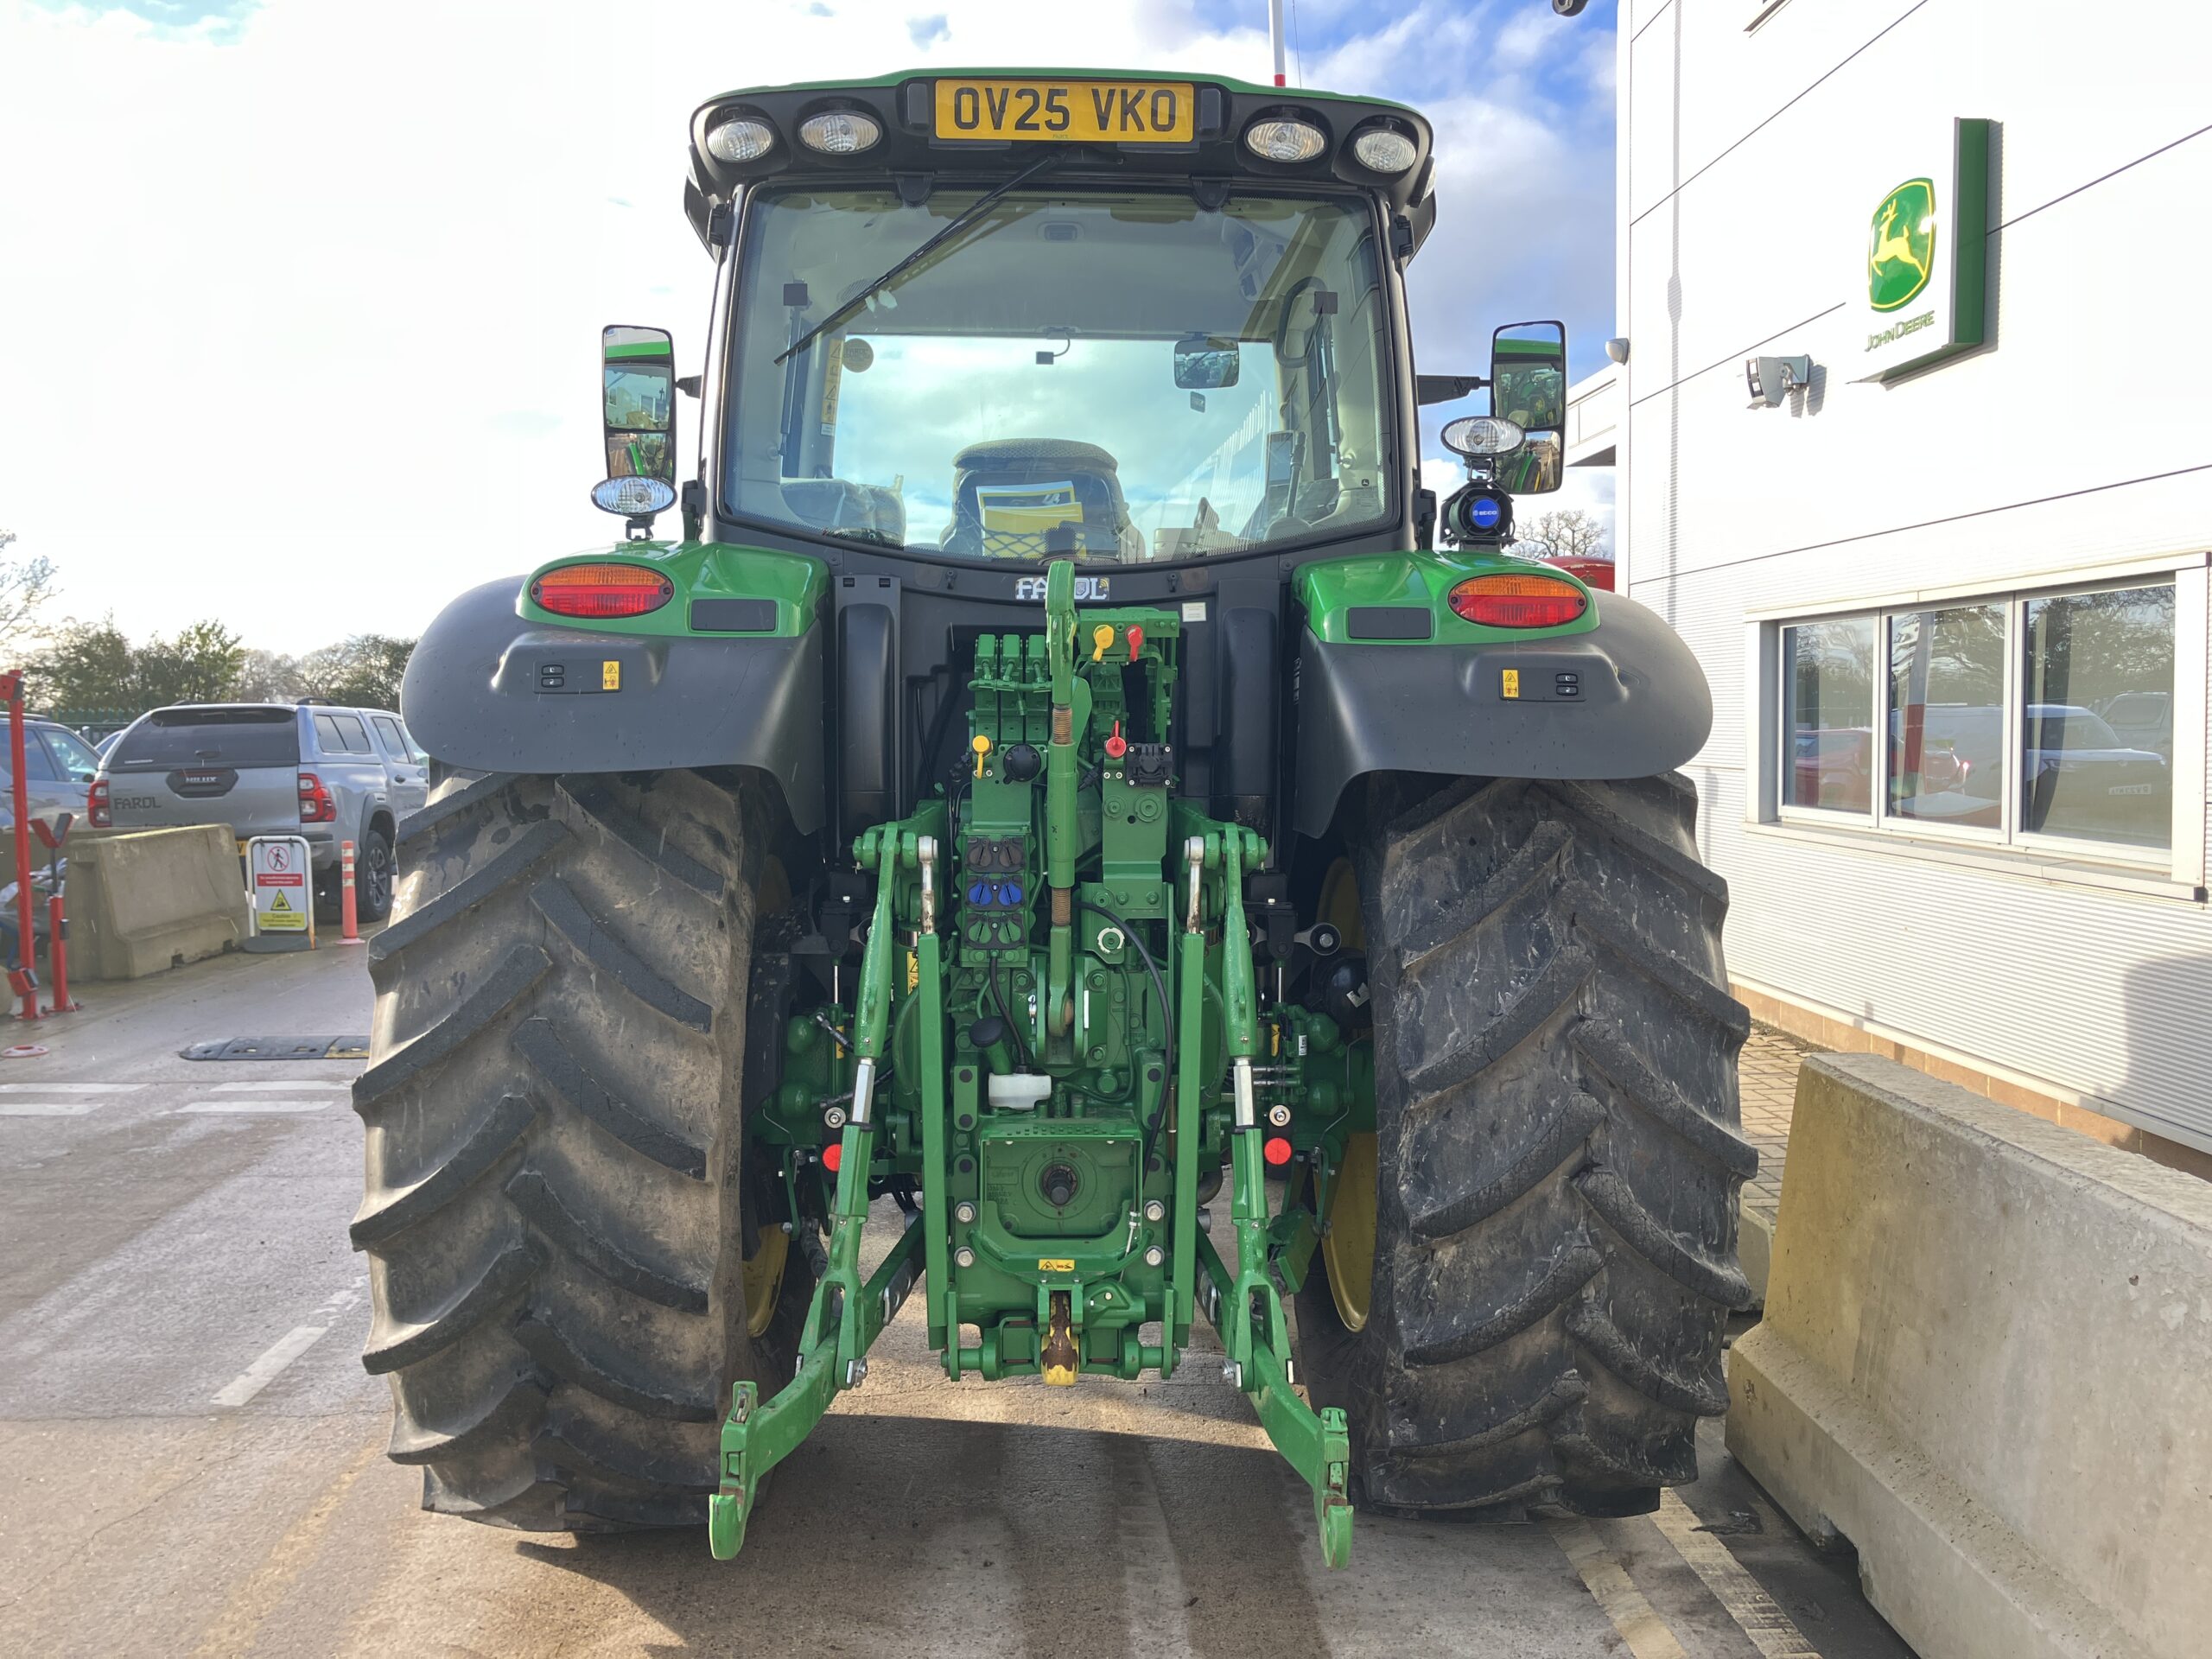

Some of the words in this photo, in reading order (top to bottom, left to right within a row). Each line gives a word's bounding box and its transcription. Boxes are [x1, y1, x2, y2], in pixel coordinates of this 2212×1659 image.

[954, 87, 1070, 130] OV25
[1091, 88, 1177, 131] VKO
[1865, 327, 1895, 353] JOHN
[1895, 310, 1935, 340] DEERE
[1015, 577, 1108, 601] FAOL
[114, 797, 162, 810] FAROL
